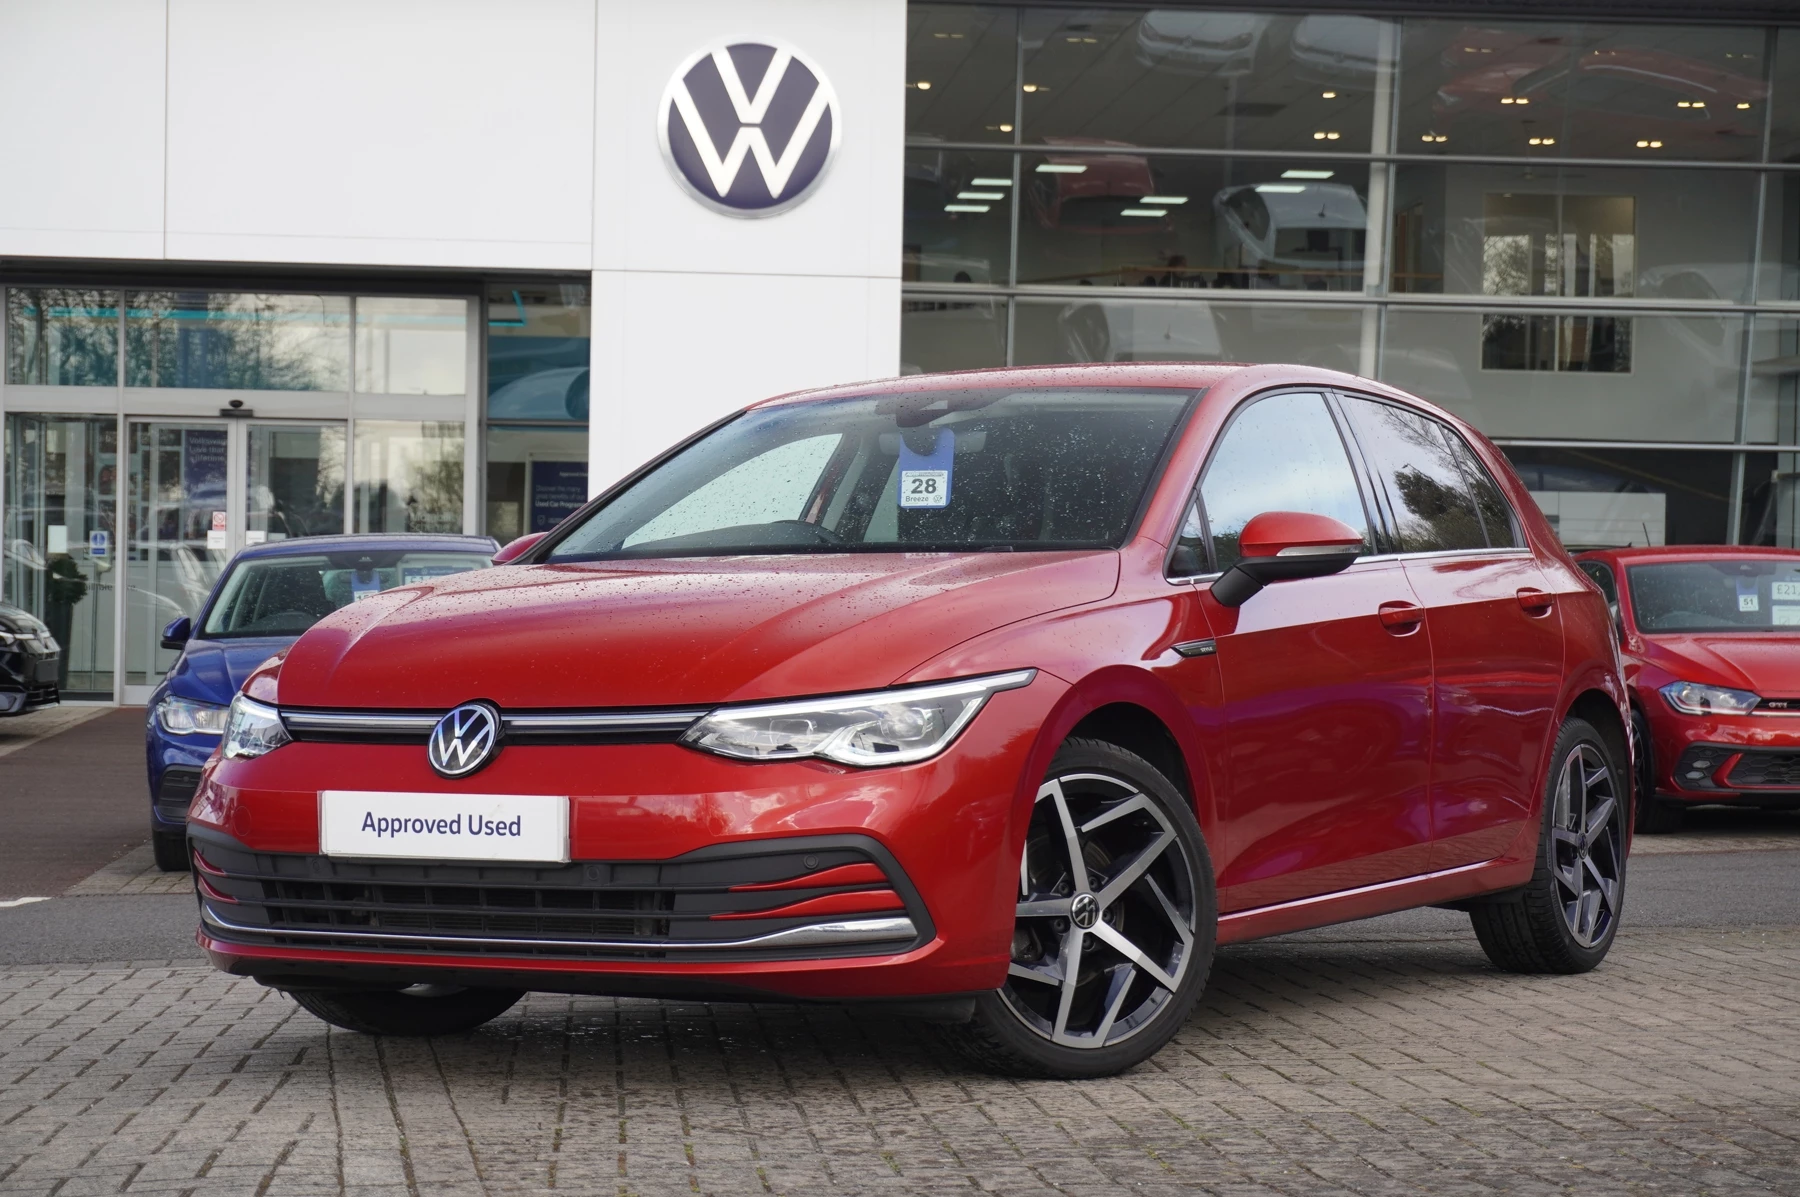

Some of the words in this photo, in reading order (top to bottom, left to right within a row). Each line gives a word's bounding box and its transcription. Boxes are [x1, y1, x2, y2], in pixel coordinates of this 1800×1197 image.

[663, 40, 837, 207] VW
[911, 479, 936, 494] 28
[1743, 598, 1754, 606] 51
[432, 704, 495, 771] VW
[361, 811, 462, 838] Approved
[468, 814, 522, 837] Used
